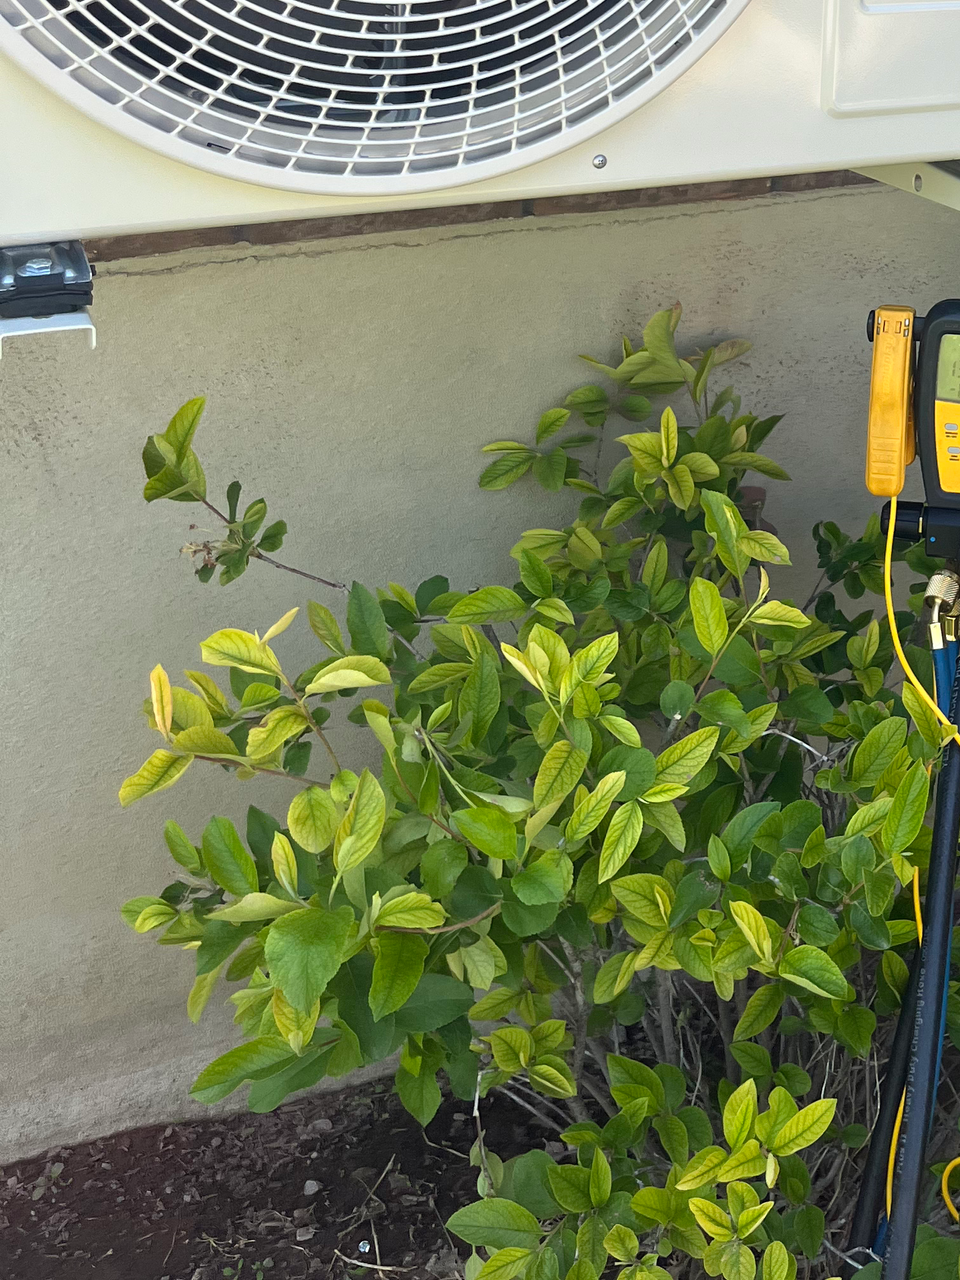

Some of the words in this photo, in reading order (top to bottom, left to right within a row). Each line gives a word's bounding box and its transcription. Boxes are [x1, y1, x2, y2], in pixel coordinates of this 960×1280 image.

[917, 967, 926, 997] Hose
[911, 999, 926, 1052] Charging
[908, 1056, 919, 1082] Duty
[903, 1084, 915, 1122] Heavy
